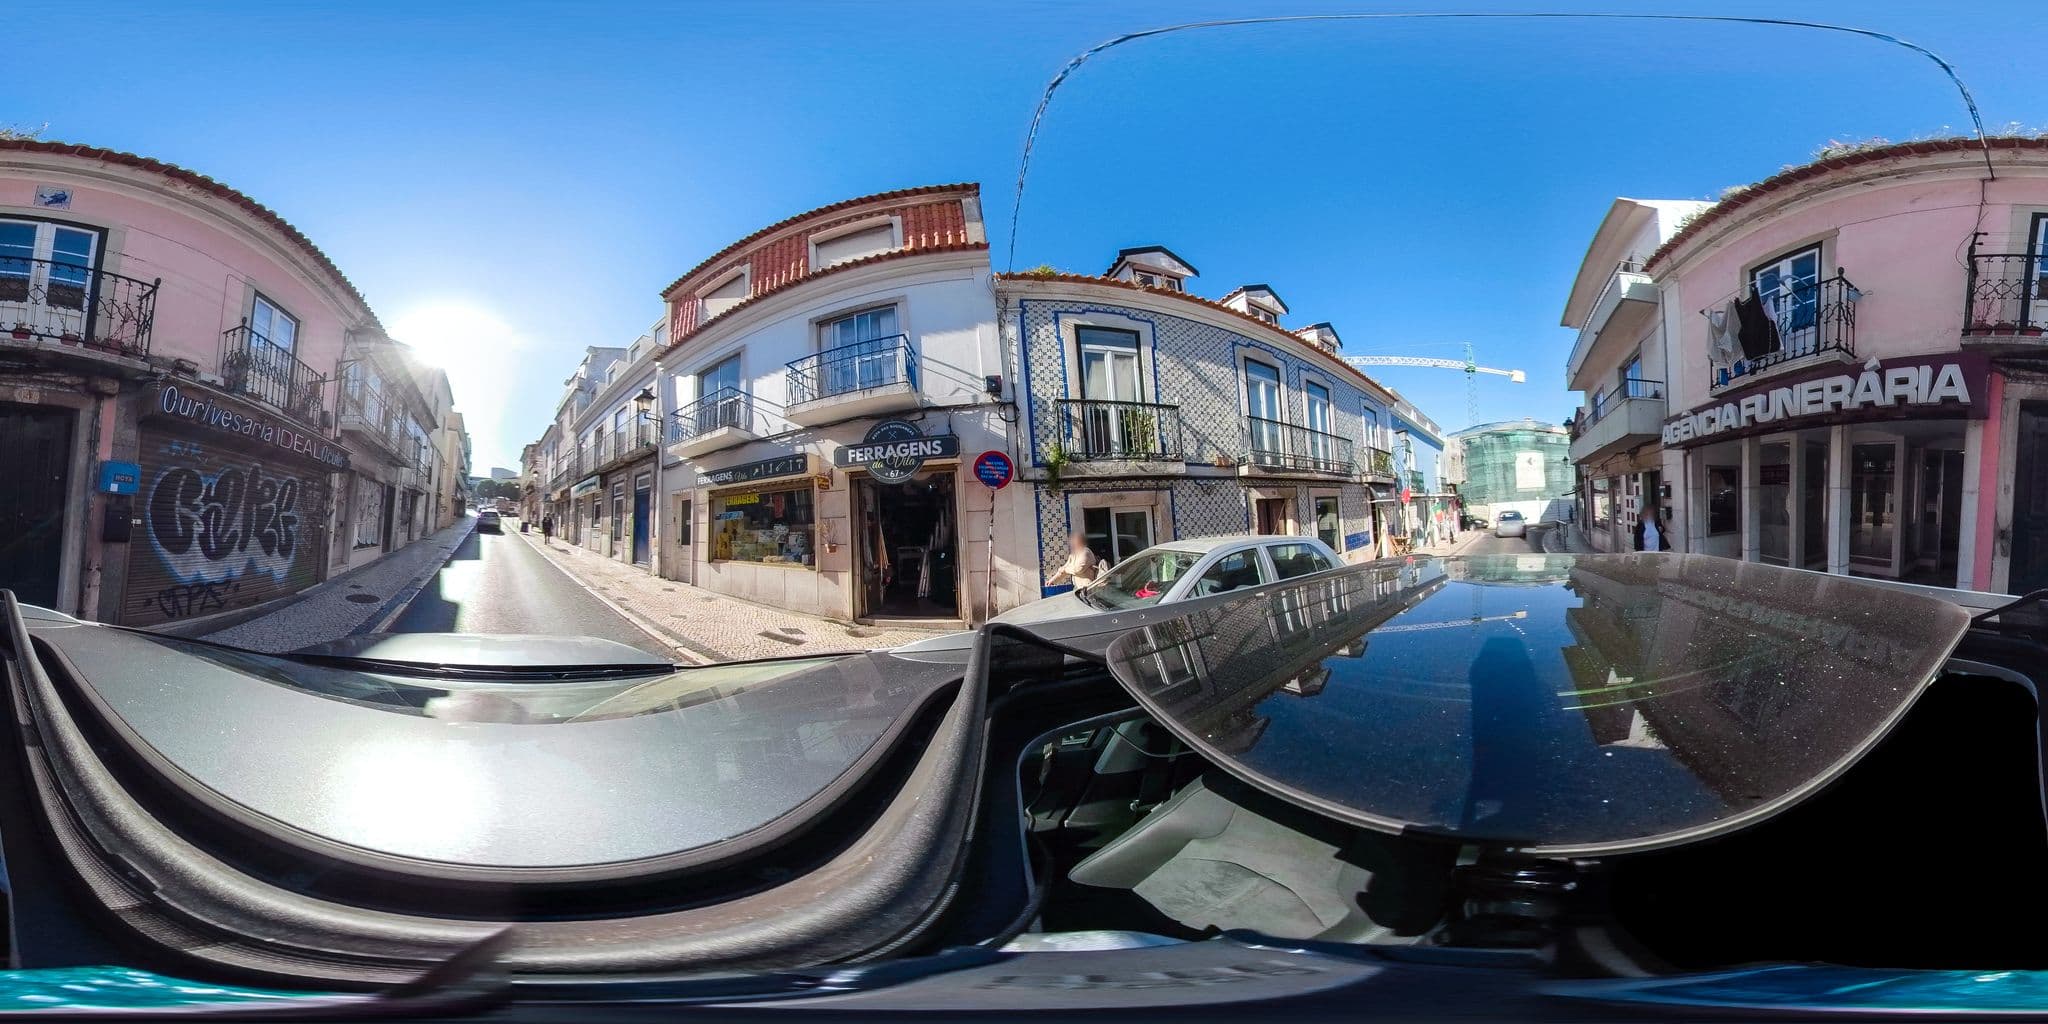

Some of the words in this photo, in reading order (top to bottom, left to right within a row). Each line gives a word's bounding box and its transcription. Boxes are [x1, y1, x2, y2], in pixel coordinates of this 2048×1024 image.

[1661, 404, 1741, 447] AGÊNCIA
[1740, 356, 1971, 427] FUNERÁRIA
[163, 385, 273, 444] Ourivesaria
[276, 426, 321, 462] IDEAL
[848, 440, 943, 463] FERRAGENS
[872, 459, 884, 469] da
[886, 453, 915, 469] Vila
[697, 471, 733, 486] FERRAGENS
[889, 470, 899, 479] 67
